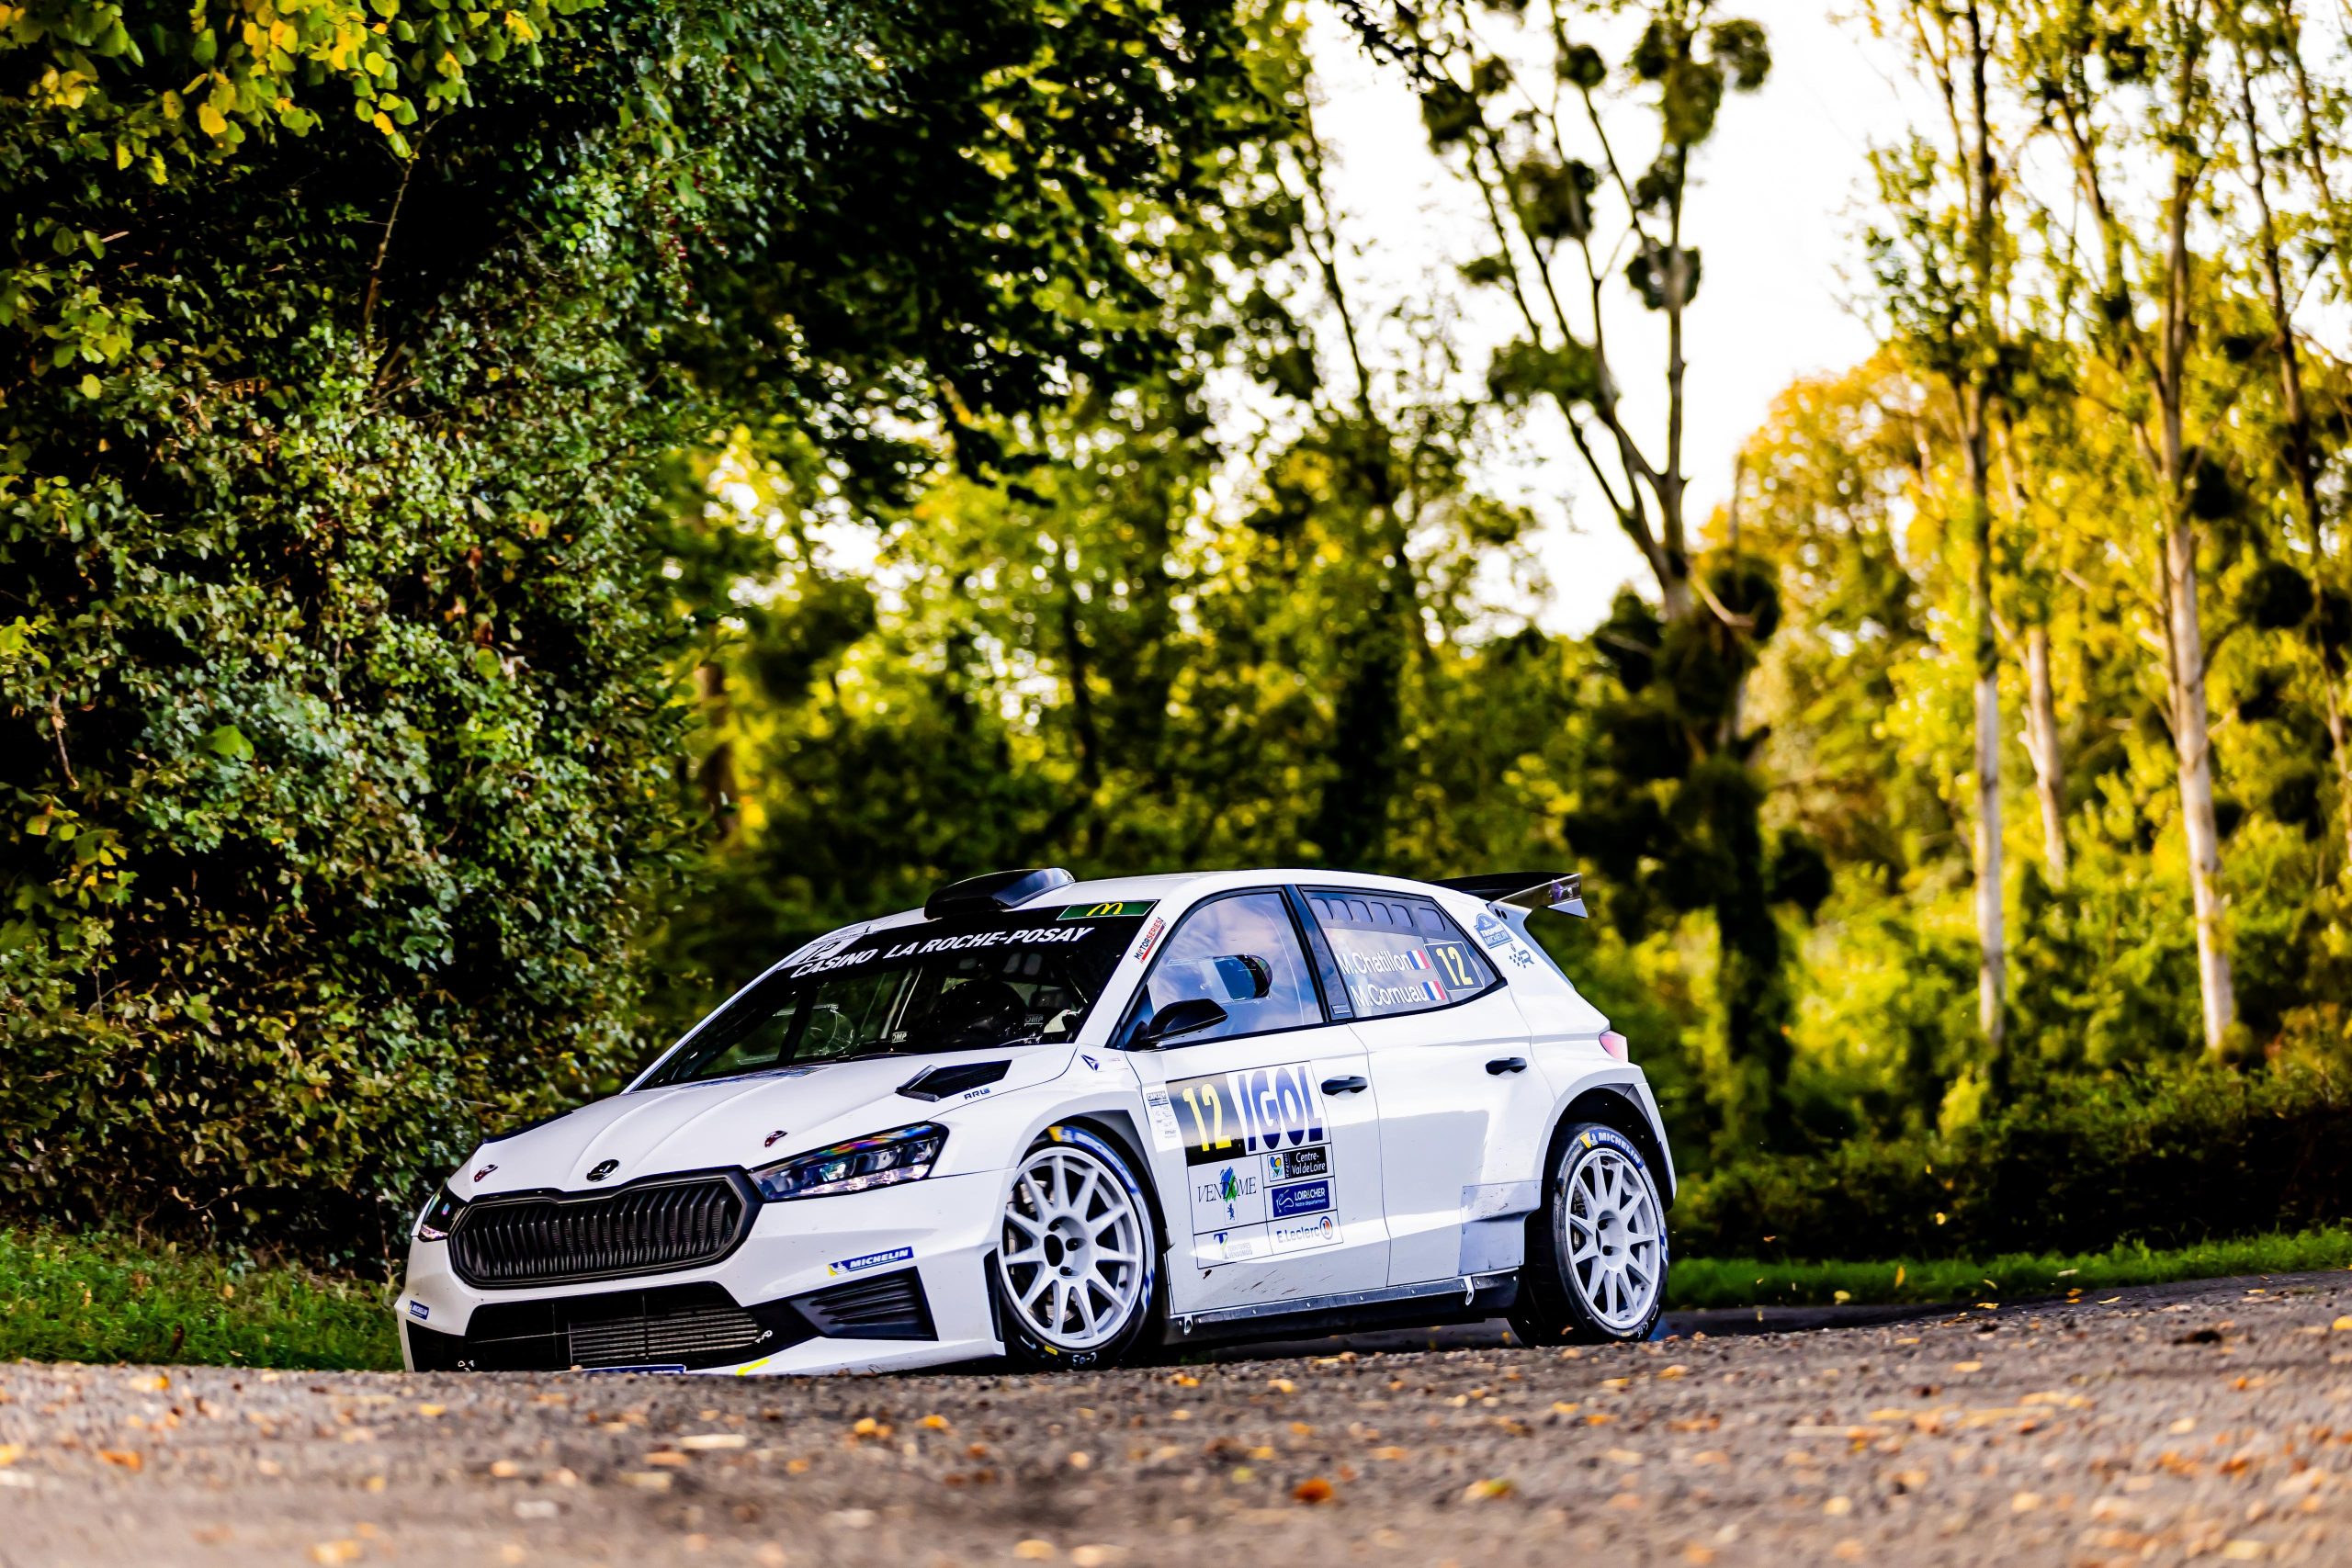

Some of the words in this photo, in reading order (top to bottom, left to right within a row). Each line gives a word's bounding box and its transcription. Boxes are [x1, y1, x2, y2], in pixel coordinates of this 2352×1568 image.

[790, 949, 878, 978] CASINO
[883, 942, 919, 959] LA
[918, 927, 1095, 953] ROCHE-POSAY
[1335, 951, 1415, 976] M.Chatillon
[1435, 946, 1474, 986] 12
[1350, 982, 1428, 1008] M.Cornuau
[1182, 1083, 1232, 1152] 12
[1238, 1066, 1323, 1151] IGOL
[1296, 1152, 1319, 1163] Centre-
[1599, 1132, 1641, 1164] MICHELIN
[1292, 1162, 1302, 1175] Val
[1302, 1162, 1310, 1174] de
[1310, 1160, 1326, 1172] Loire
[1198, 1177, 1257, 1203] VENDÔME
[1277, 1226, 1320, 1244] E.Leclerc
[850, 1249, 909, 1269] MICHELIN
